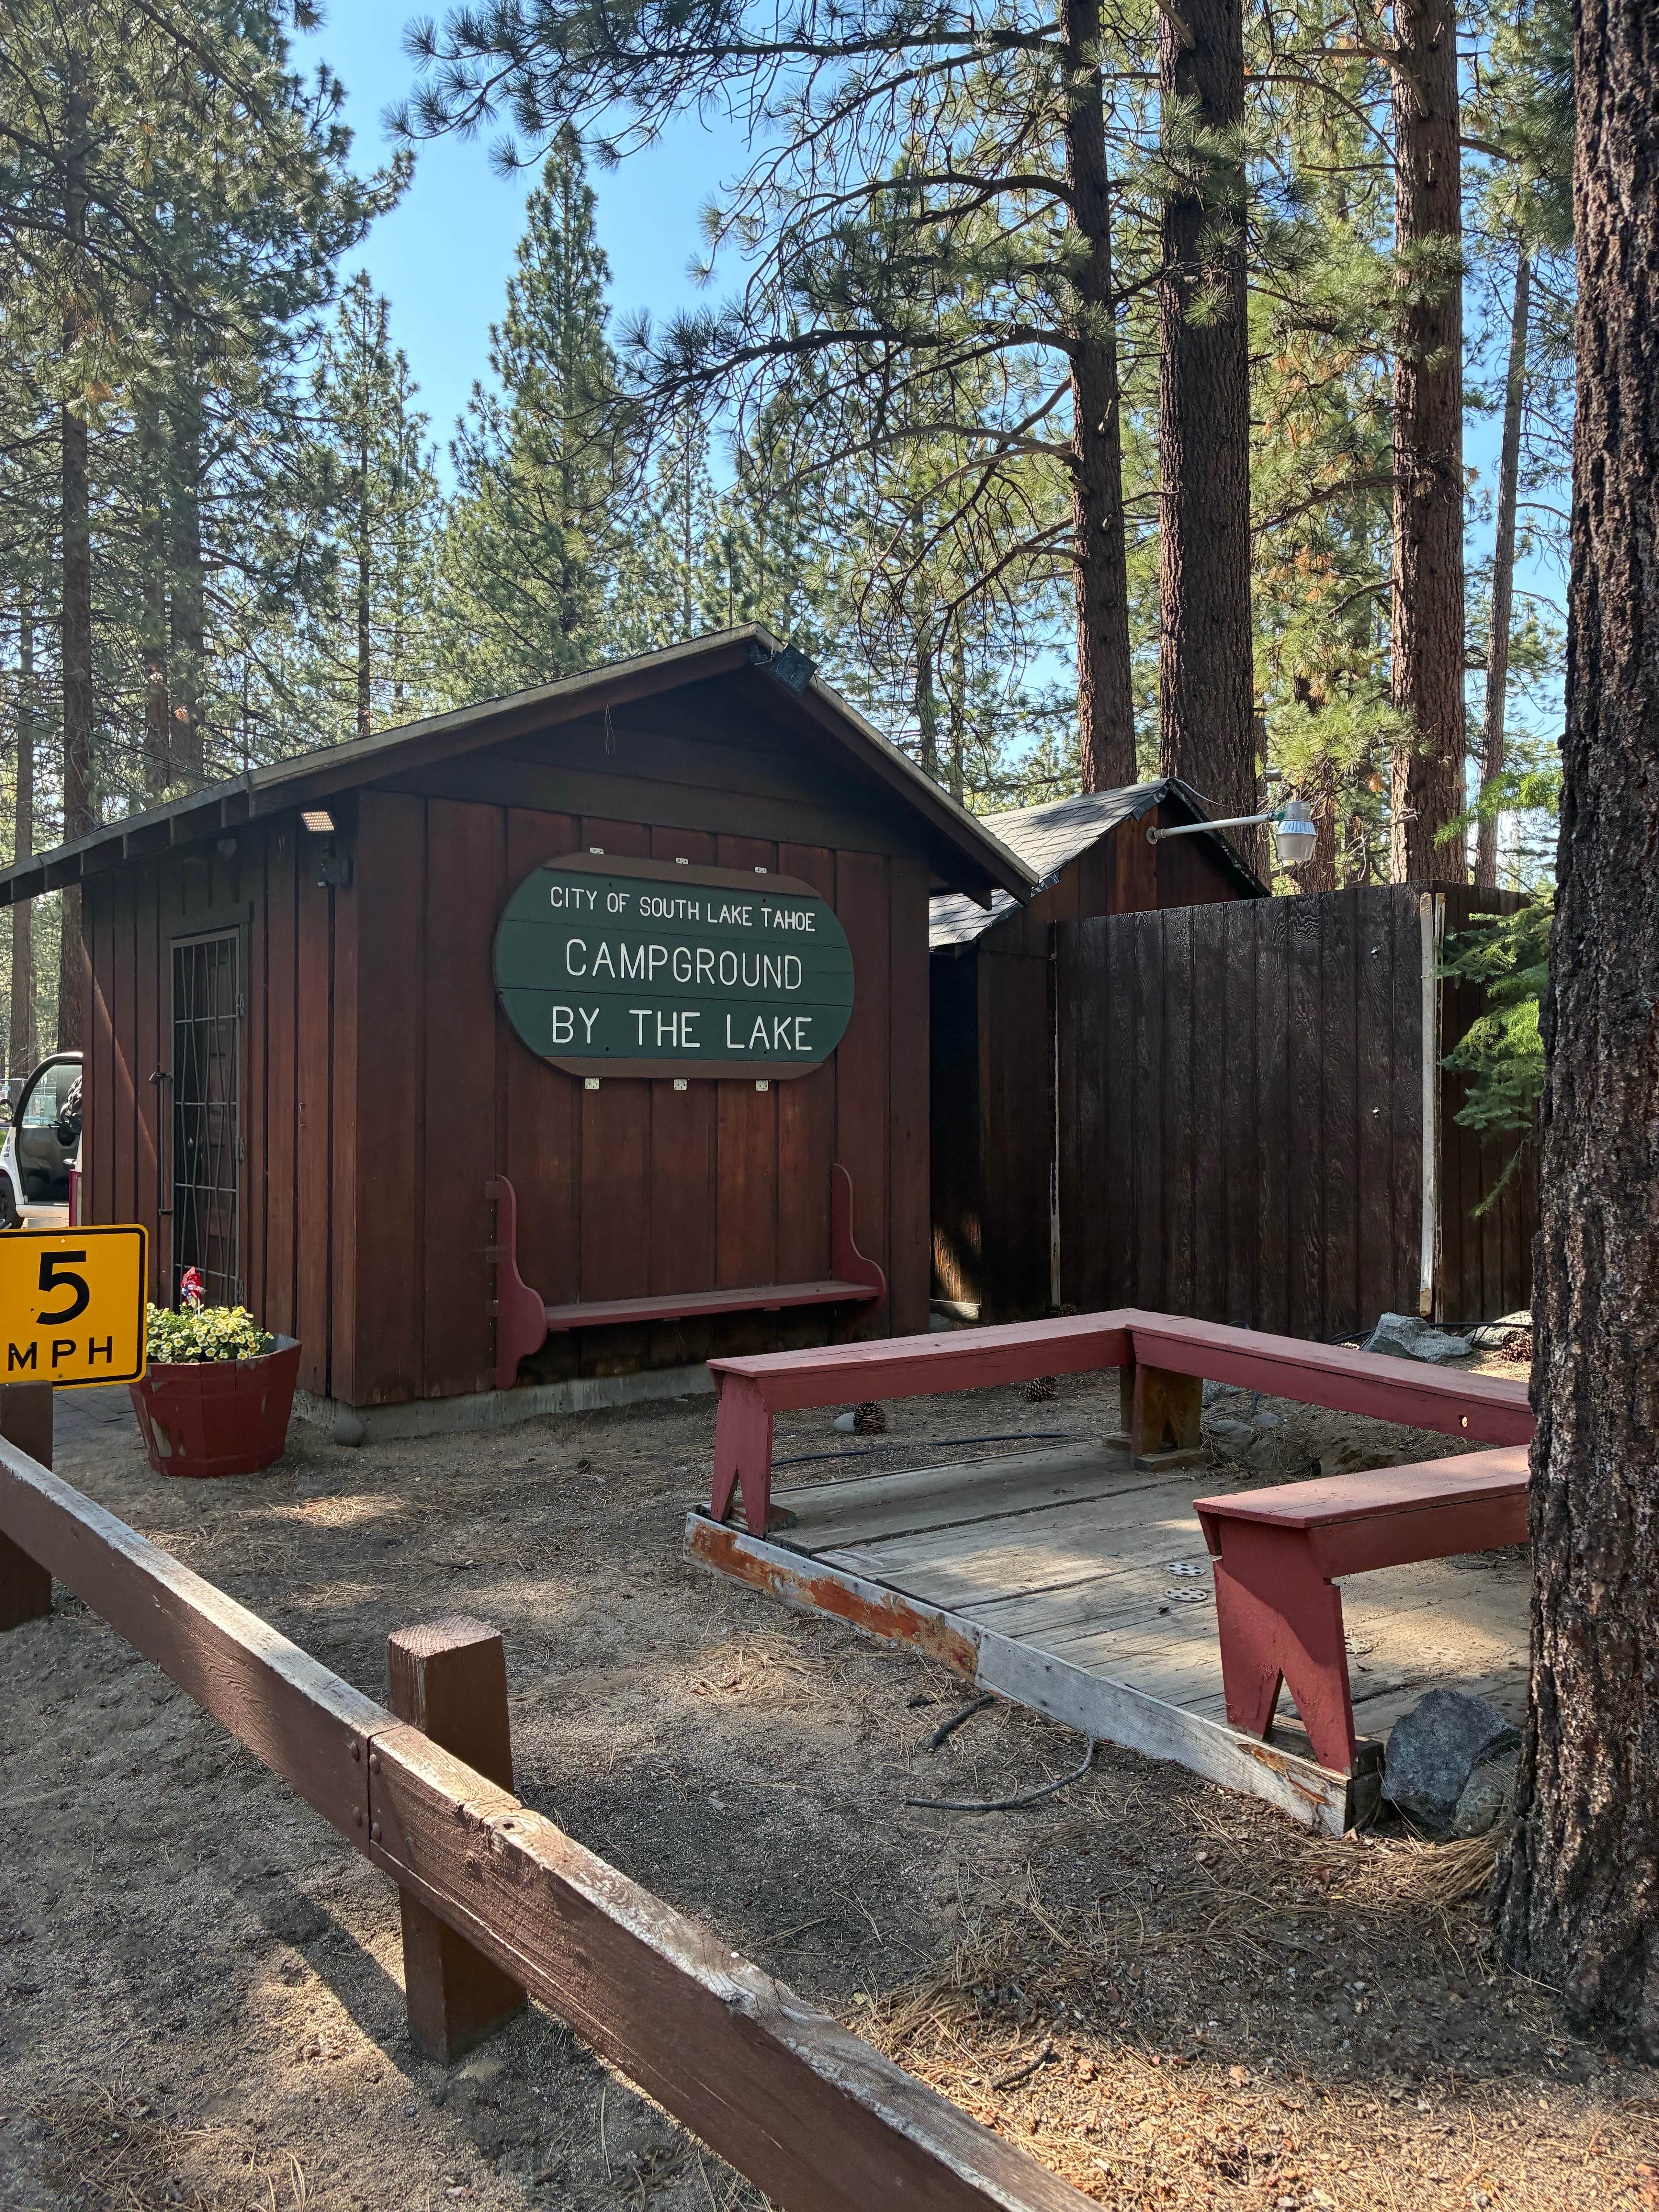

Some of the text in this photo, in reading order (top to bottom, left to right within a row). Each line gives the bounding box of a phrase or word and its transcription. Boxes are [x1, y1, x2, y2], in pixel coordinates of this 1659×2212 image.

[550, 886, 816, 932] CITY OF SOUTH LAKE TAHOE
[566, 938, 802, 990] CAMPGROUND
[552, 1005, 812, 1051] BY THE LAKE
[36, 1250, 90, 1325] 5
[8, 1335, 113, 1371] MPH
